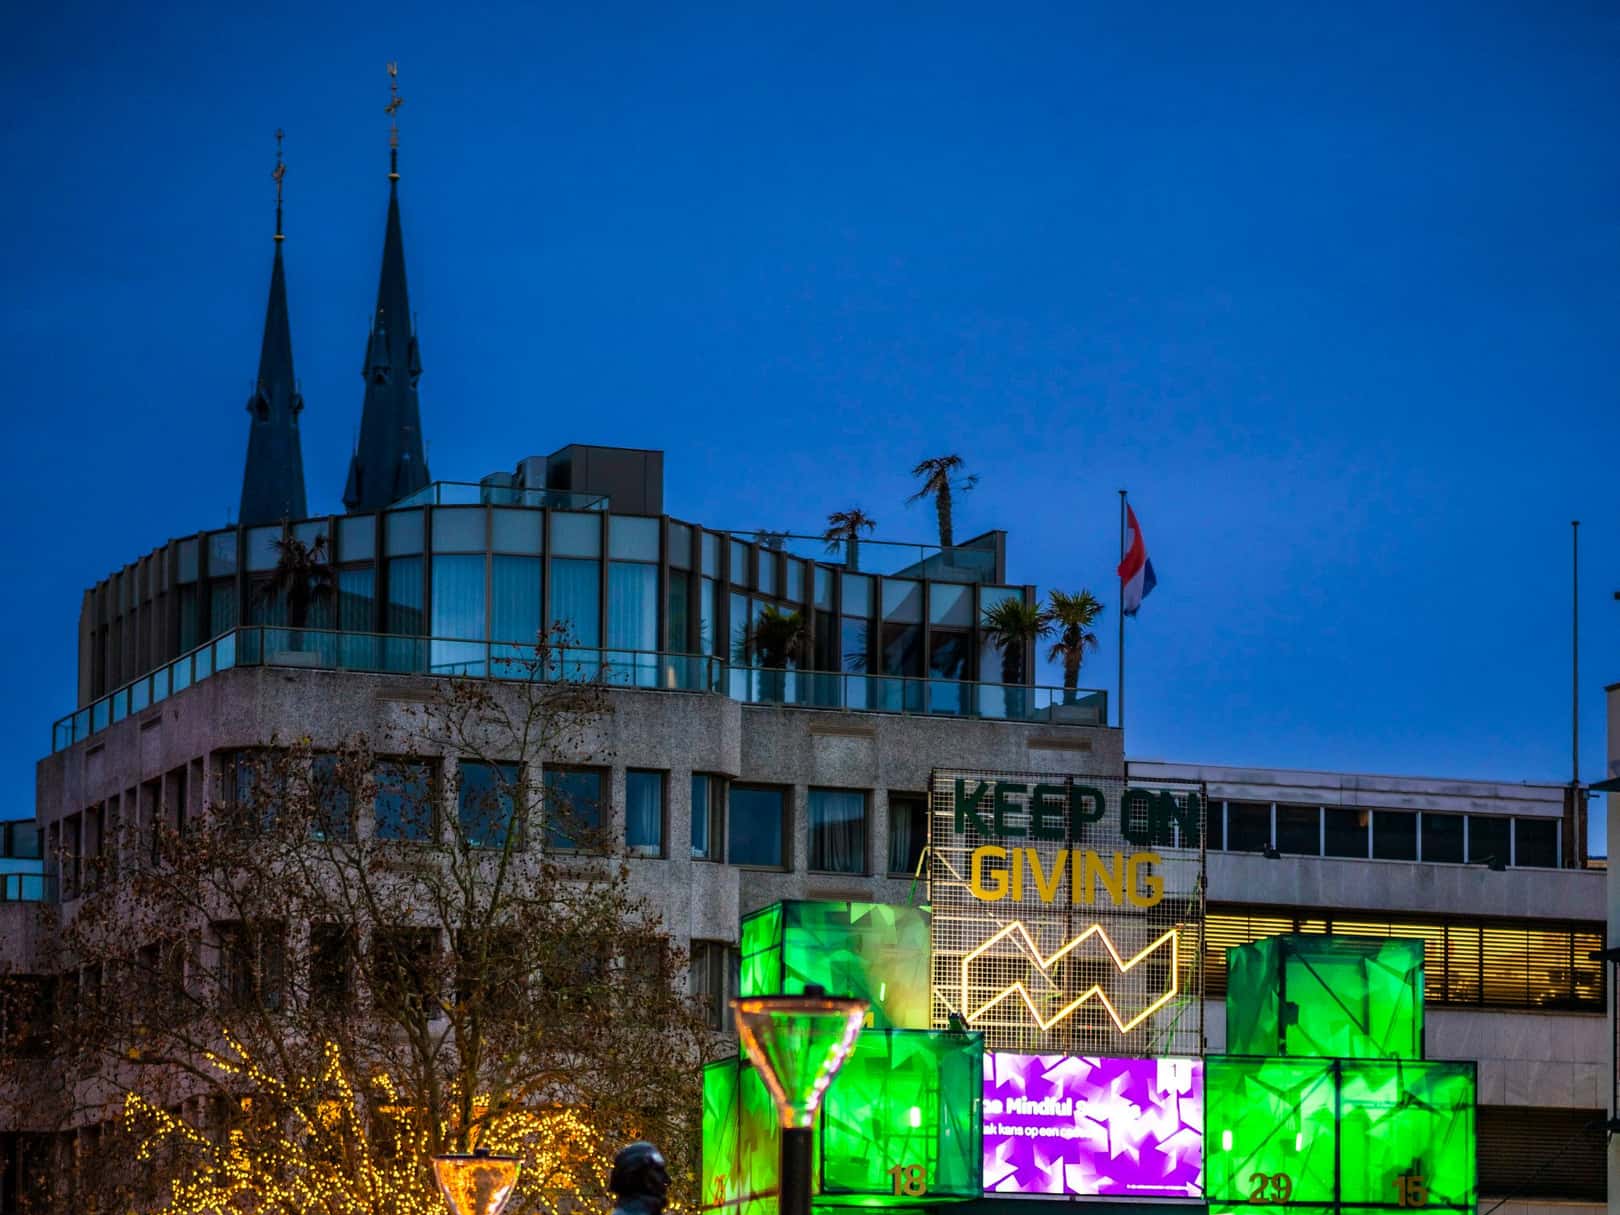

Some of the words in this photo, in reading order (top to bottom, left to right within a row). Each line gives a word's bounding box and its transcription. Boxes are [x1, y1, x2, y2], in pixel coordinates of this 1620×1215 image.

[953, 778, 1105, 842] KEEP
[1121, 789, 1200, 846] ON
[971, 845, 1164, 908] GIVING
[1006, 1096, 1072, 1116] Mindful
[1025, 1127, 1038, 1139] op
[888, 1164, 927, 1197] 18
[1249, 1173, 1292, 1204] 29
[1392, 1176, 1427, 1207] 15
